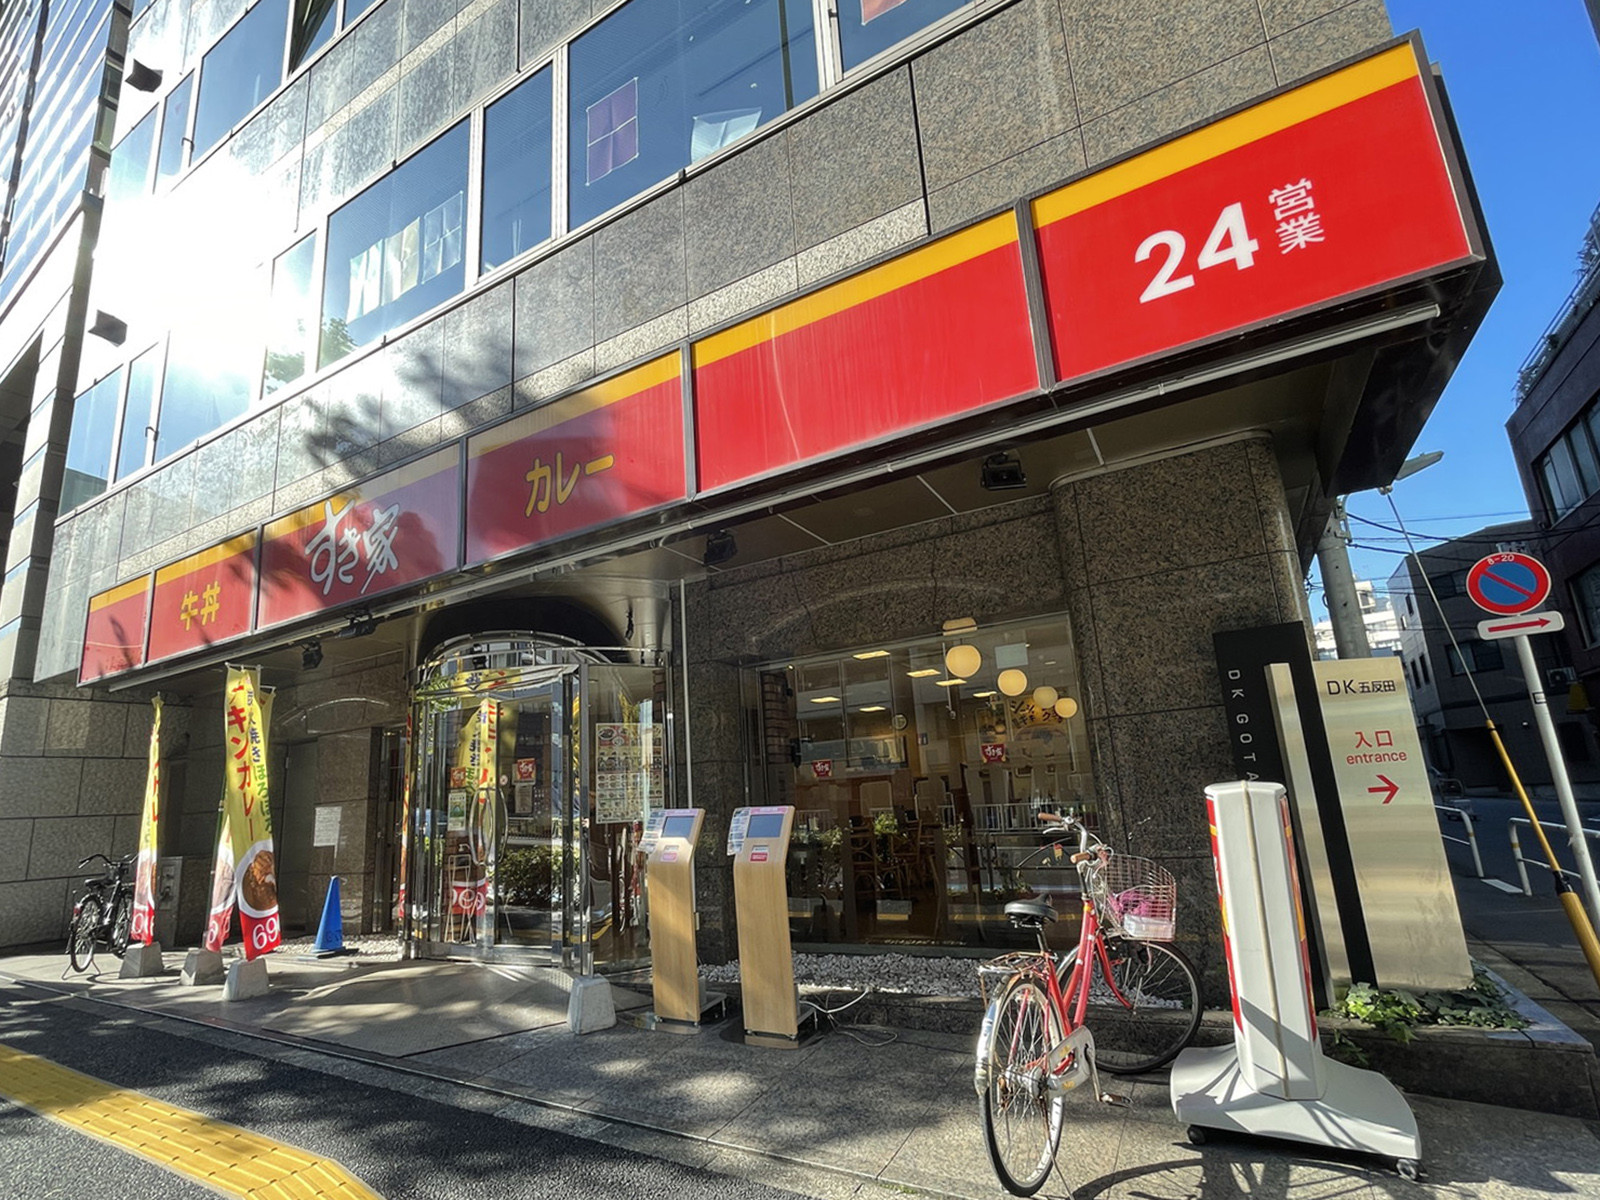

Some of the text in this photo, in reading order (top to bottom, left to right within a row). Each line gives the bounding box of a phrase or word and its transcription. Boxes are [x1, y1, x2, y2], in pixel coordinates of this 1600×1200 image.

[1135, 177, 1326, 304] 24 営業
[524, 451, 615, 519] カレー
[304, 499, 400, 596] すき家
[1486, 553, 1516, 567] 8-20
[179, 580, 221, 632] 牛丼
[1346, 751, 1408, 765] entrance
[1354, 730, 1394, 750] 入口
